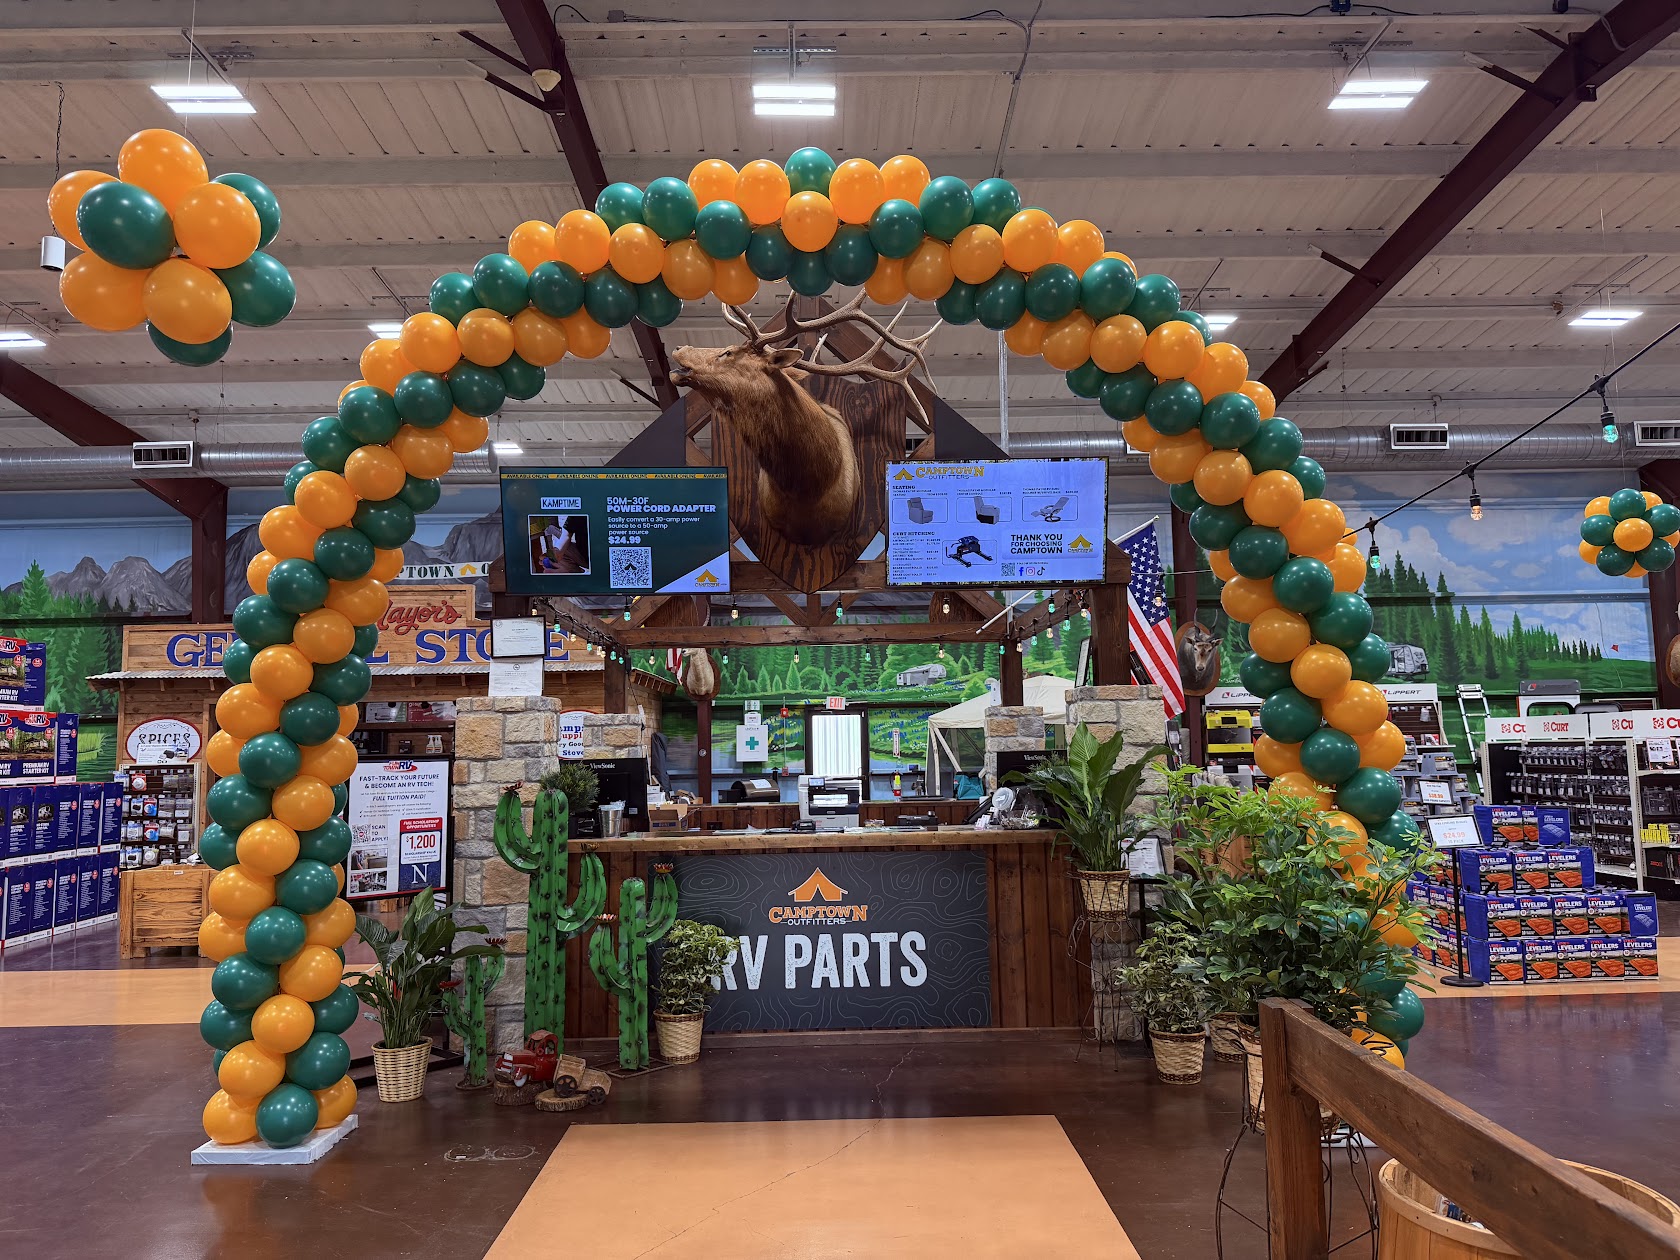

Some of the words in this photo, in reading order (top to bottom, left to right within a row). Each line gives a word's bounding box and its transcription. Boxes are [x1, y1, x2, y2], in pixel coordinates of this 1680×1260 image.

[916, 466, 984, 478] CAMPTOWN
[542, 499, 580, 508] KAMPTIME
[608, 536, 641, 544] $24.99
[6, 641, 16, 650] RV
[416, 629, 570, 662] STE
[830, 698, 843, 708] EXIT
[36, 714, 47, 723] RV
[1551, 722, 1569, 732] CURT
[138, 733, 191, 748] SPICES
[399, 761, 413, 770] RV
[406, 834, 436, 850] $1,200
[412, 864, 429, 883] N
[769, 905, 868, 923] CAMPTOWN
[788, 918, 846, 926] OUTFITTERS
[710, 935, 768, 990] RV
[785, 931, 928, 989] PARTS
